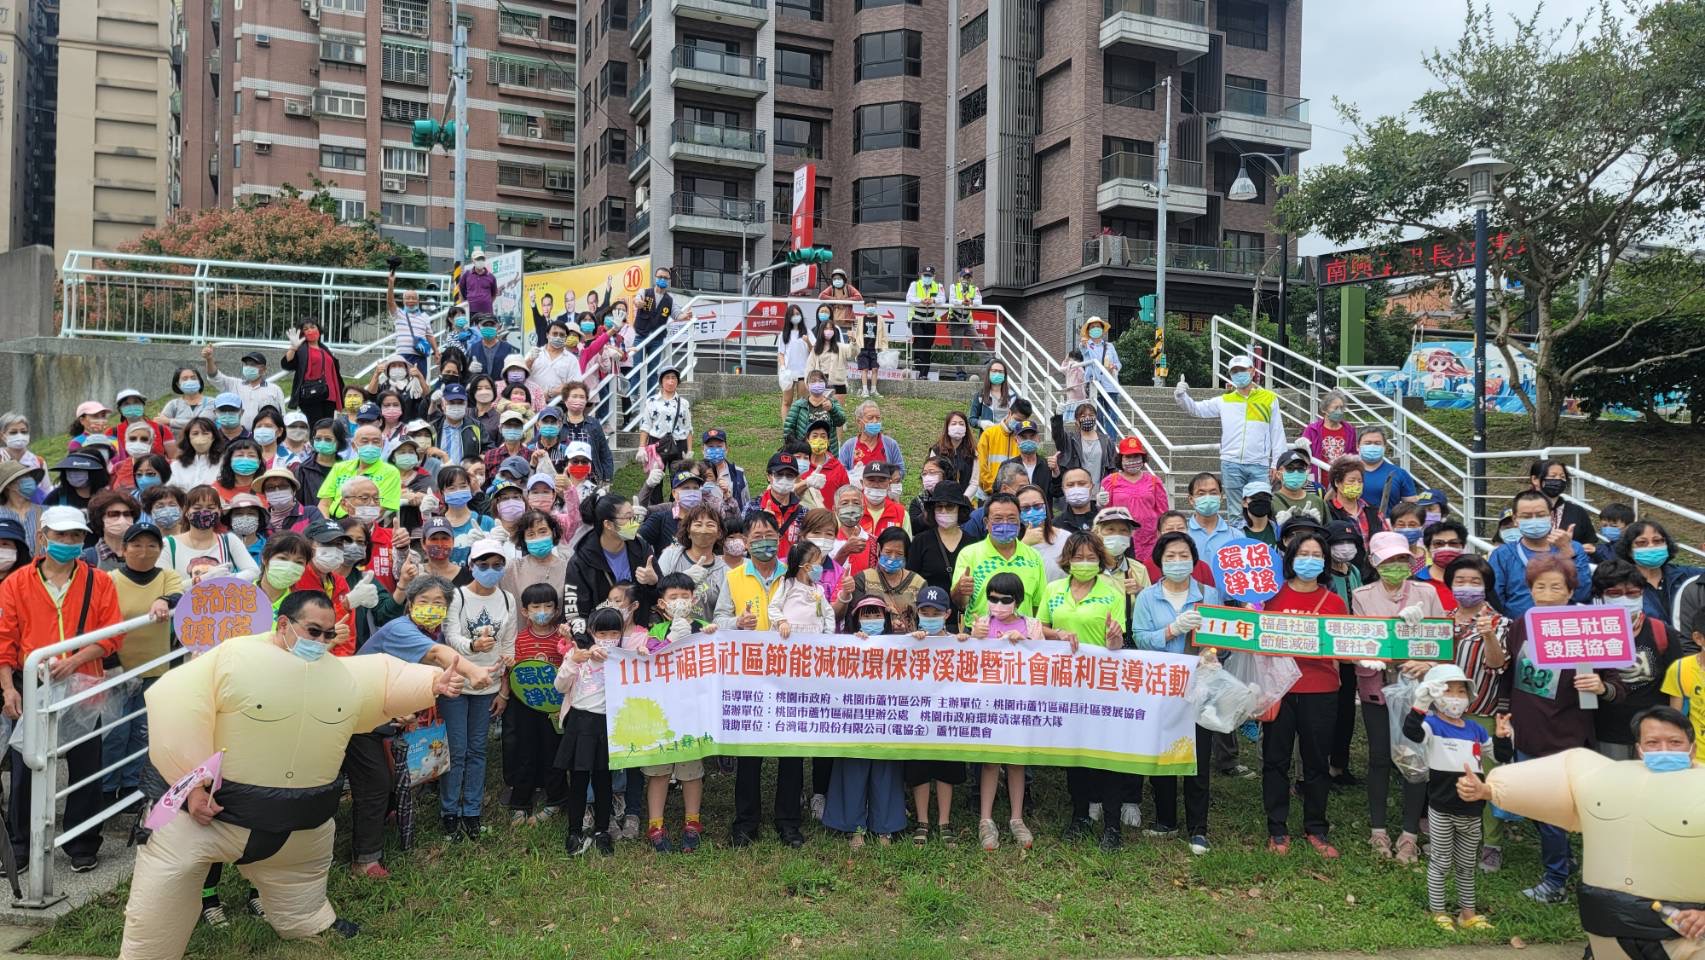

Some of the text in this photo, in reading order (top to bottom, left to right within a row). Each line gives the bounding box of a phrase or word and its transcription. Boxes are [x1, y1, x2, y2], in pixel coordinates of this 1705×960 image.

[625, 267, 642, 288] 10
[1217, 543, 1273, 570] 環保
[1540, 616, 1622, 638] 福昌社區
[1411, 642, 1438, 656] 活動
[1544, 638, 1624, 658] 發展協會
[619, 641, 1190, 698] 111年福昌社區節能減碳環保淨溪趣暨社會福利宣導活動
[936, 725, 992, 739] 蘆竹區農會
